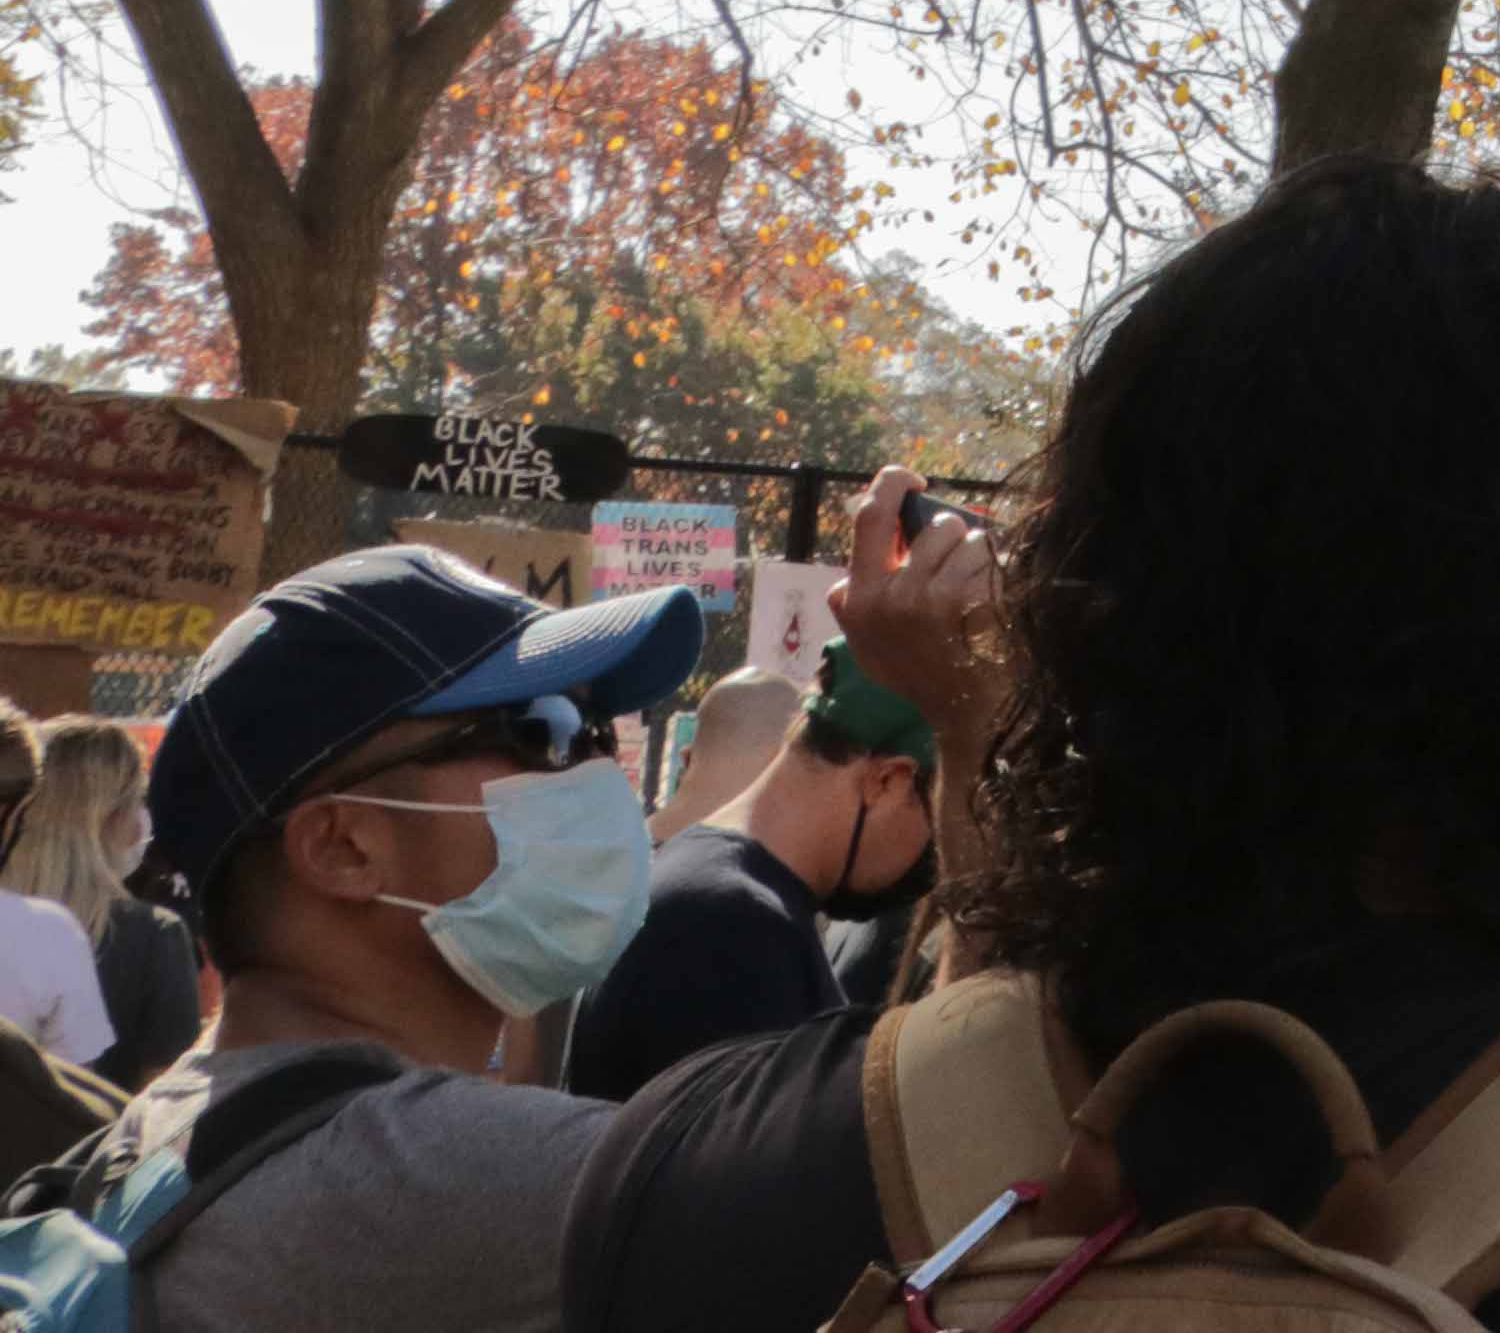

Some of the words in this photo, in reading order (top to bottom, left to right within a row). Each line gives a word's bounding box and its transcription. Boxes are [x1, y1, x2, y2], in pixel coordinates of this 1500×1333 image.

[435, 415, 541, 452] BLACK
[445, 444, 554, 475] LIVES
[410, 463, 565, 501] MATTER
[622, 516, 709, 533] BLACK
[622, 539, 709, 556] TRANS
[627, 560, 702, 577] LIVES
[610, 582, 717, 599] MAR
